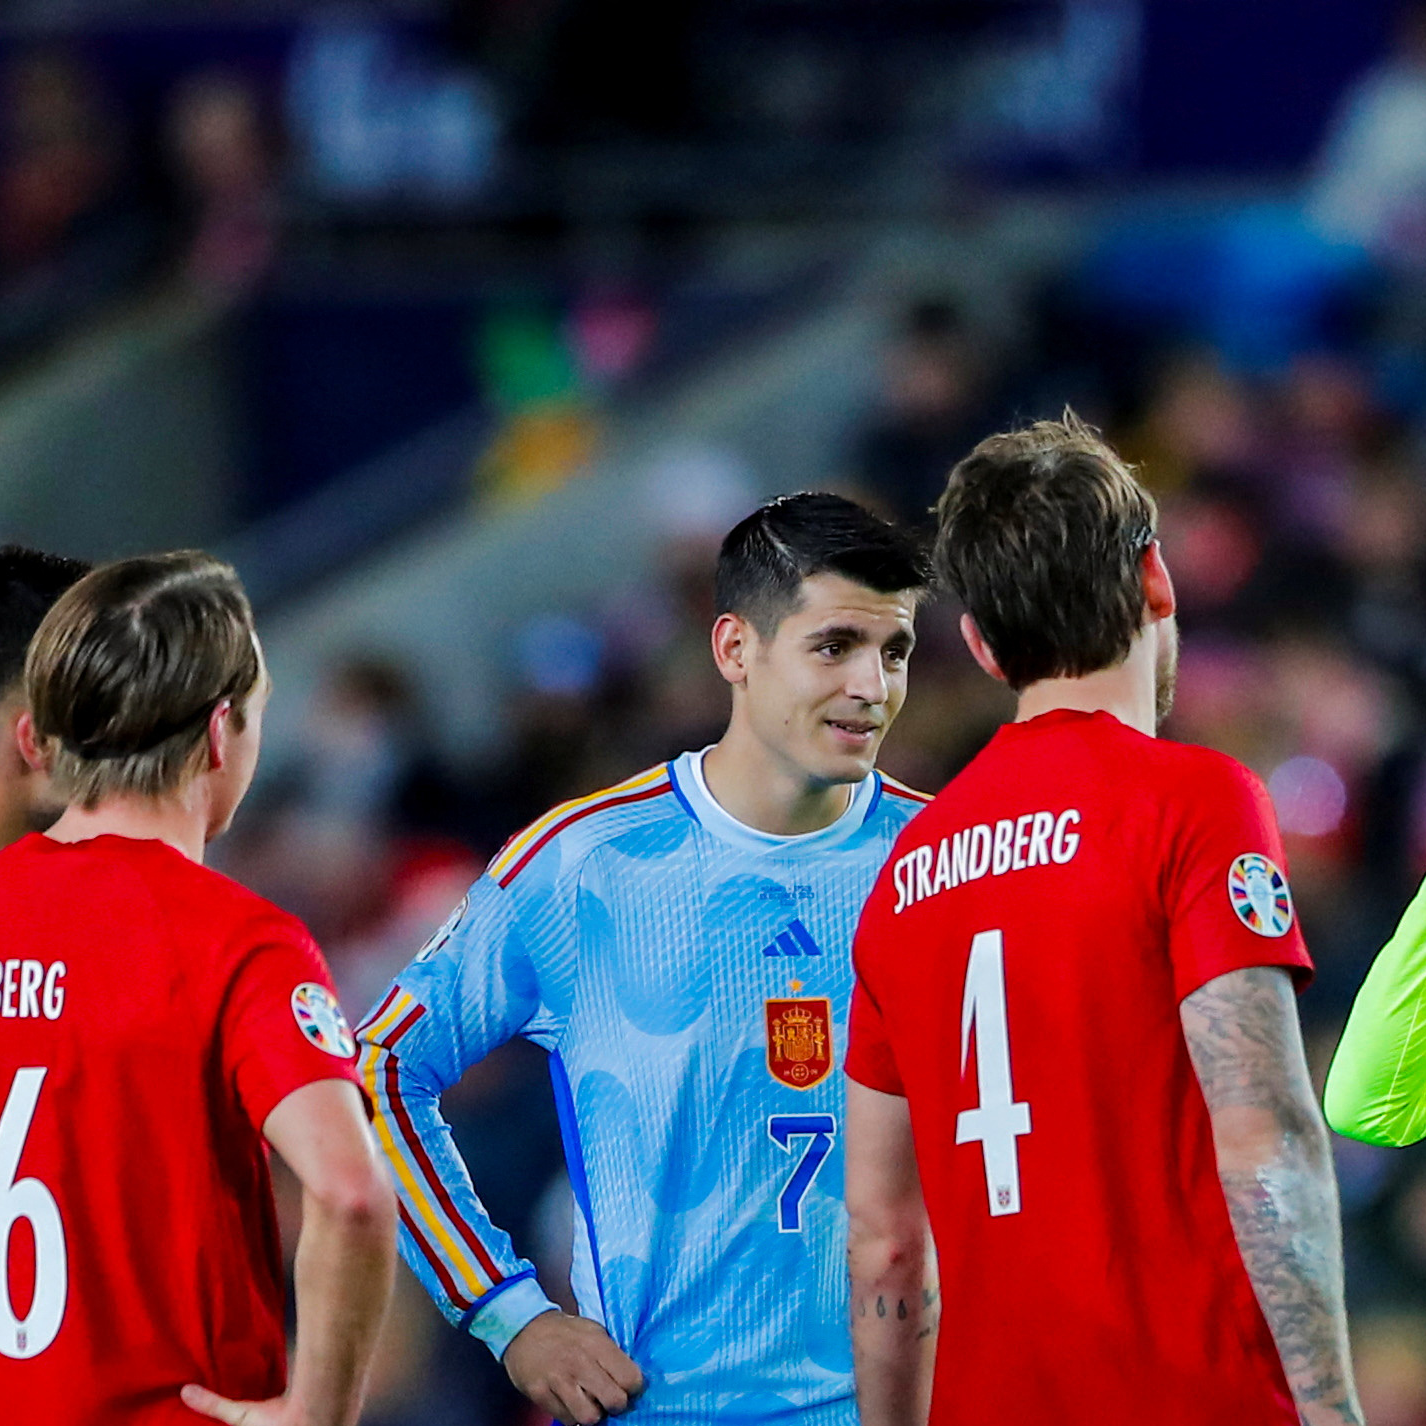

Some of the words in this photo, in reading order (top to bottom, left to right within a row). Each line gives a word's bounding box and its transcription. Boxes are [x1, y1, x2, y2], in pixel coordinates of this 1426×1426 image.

[892, 809, 1080, 914] STRANDBERG
[955, 929, 1032, 1217] 4
[766, 1113, 837, 1234] 7
